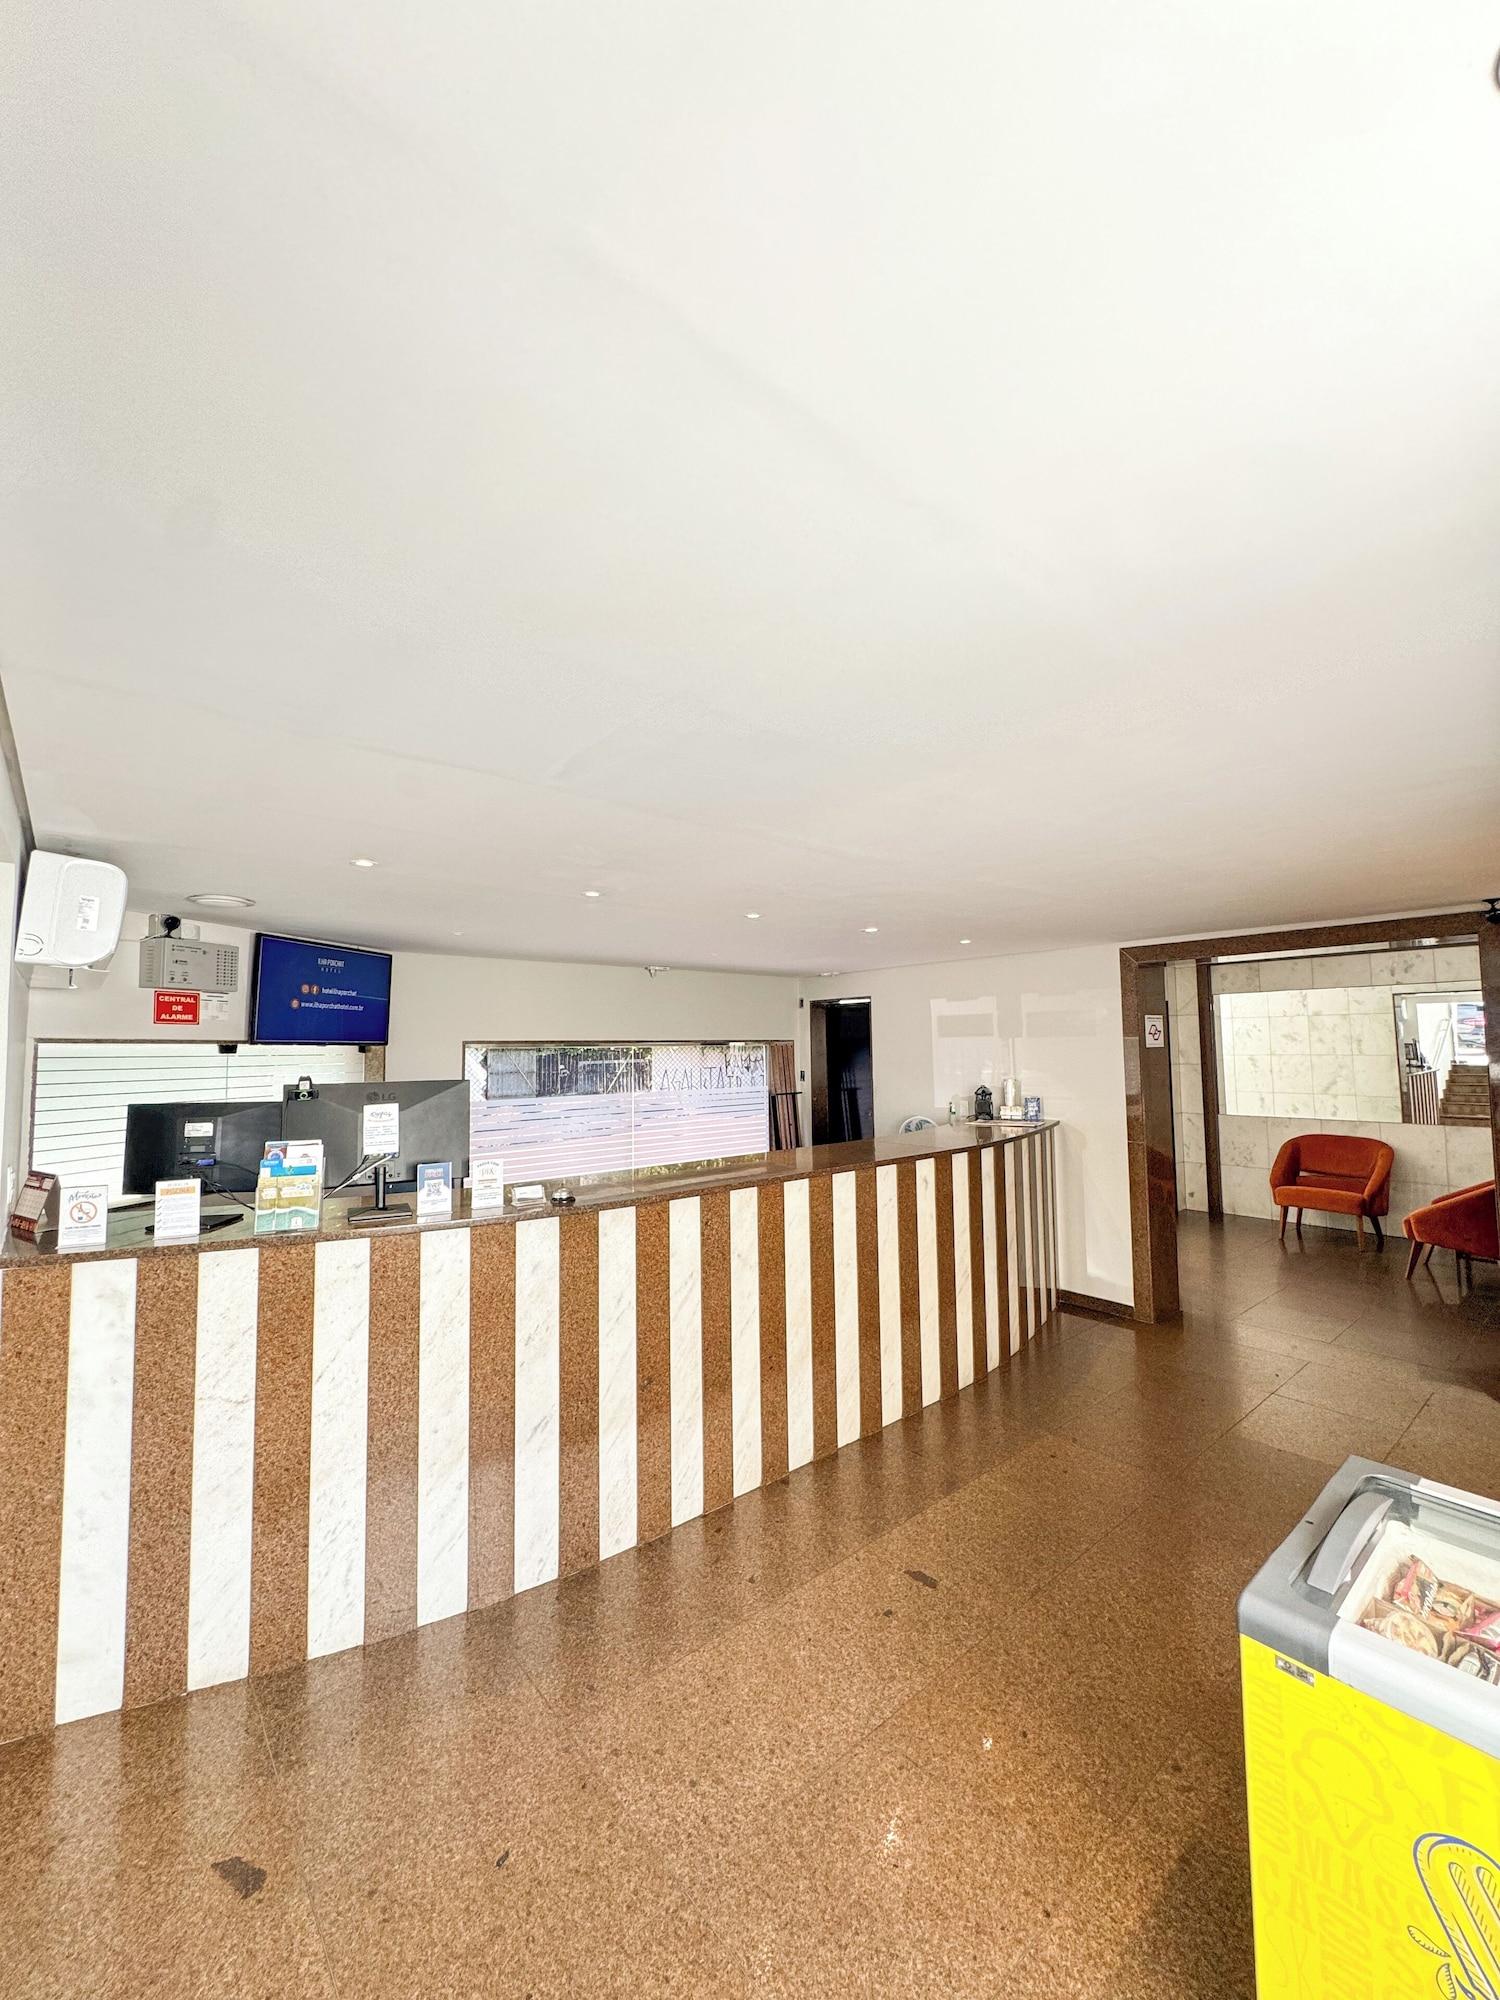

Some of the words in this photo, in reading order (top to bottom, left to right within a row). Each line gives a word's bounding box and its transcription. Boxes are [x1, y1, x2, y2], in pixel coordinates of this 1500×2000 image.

[158, 995, 196, 1004] CENTRAL
[171, 1004, 184, 1012] DE
[160, 1012, 194, 1021] ALARME
[381, 1092, 396, 1101] LG
